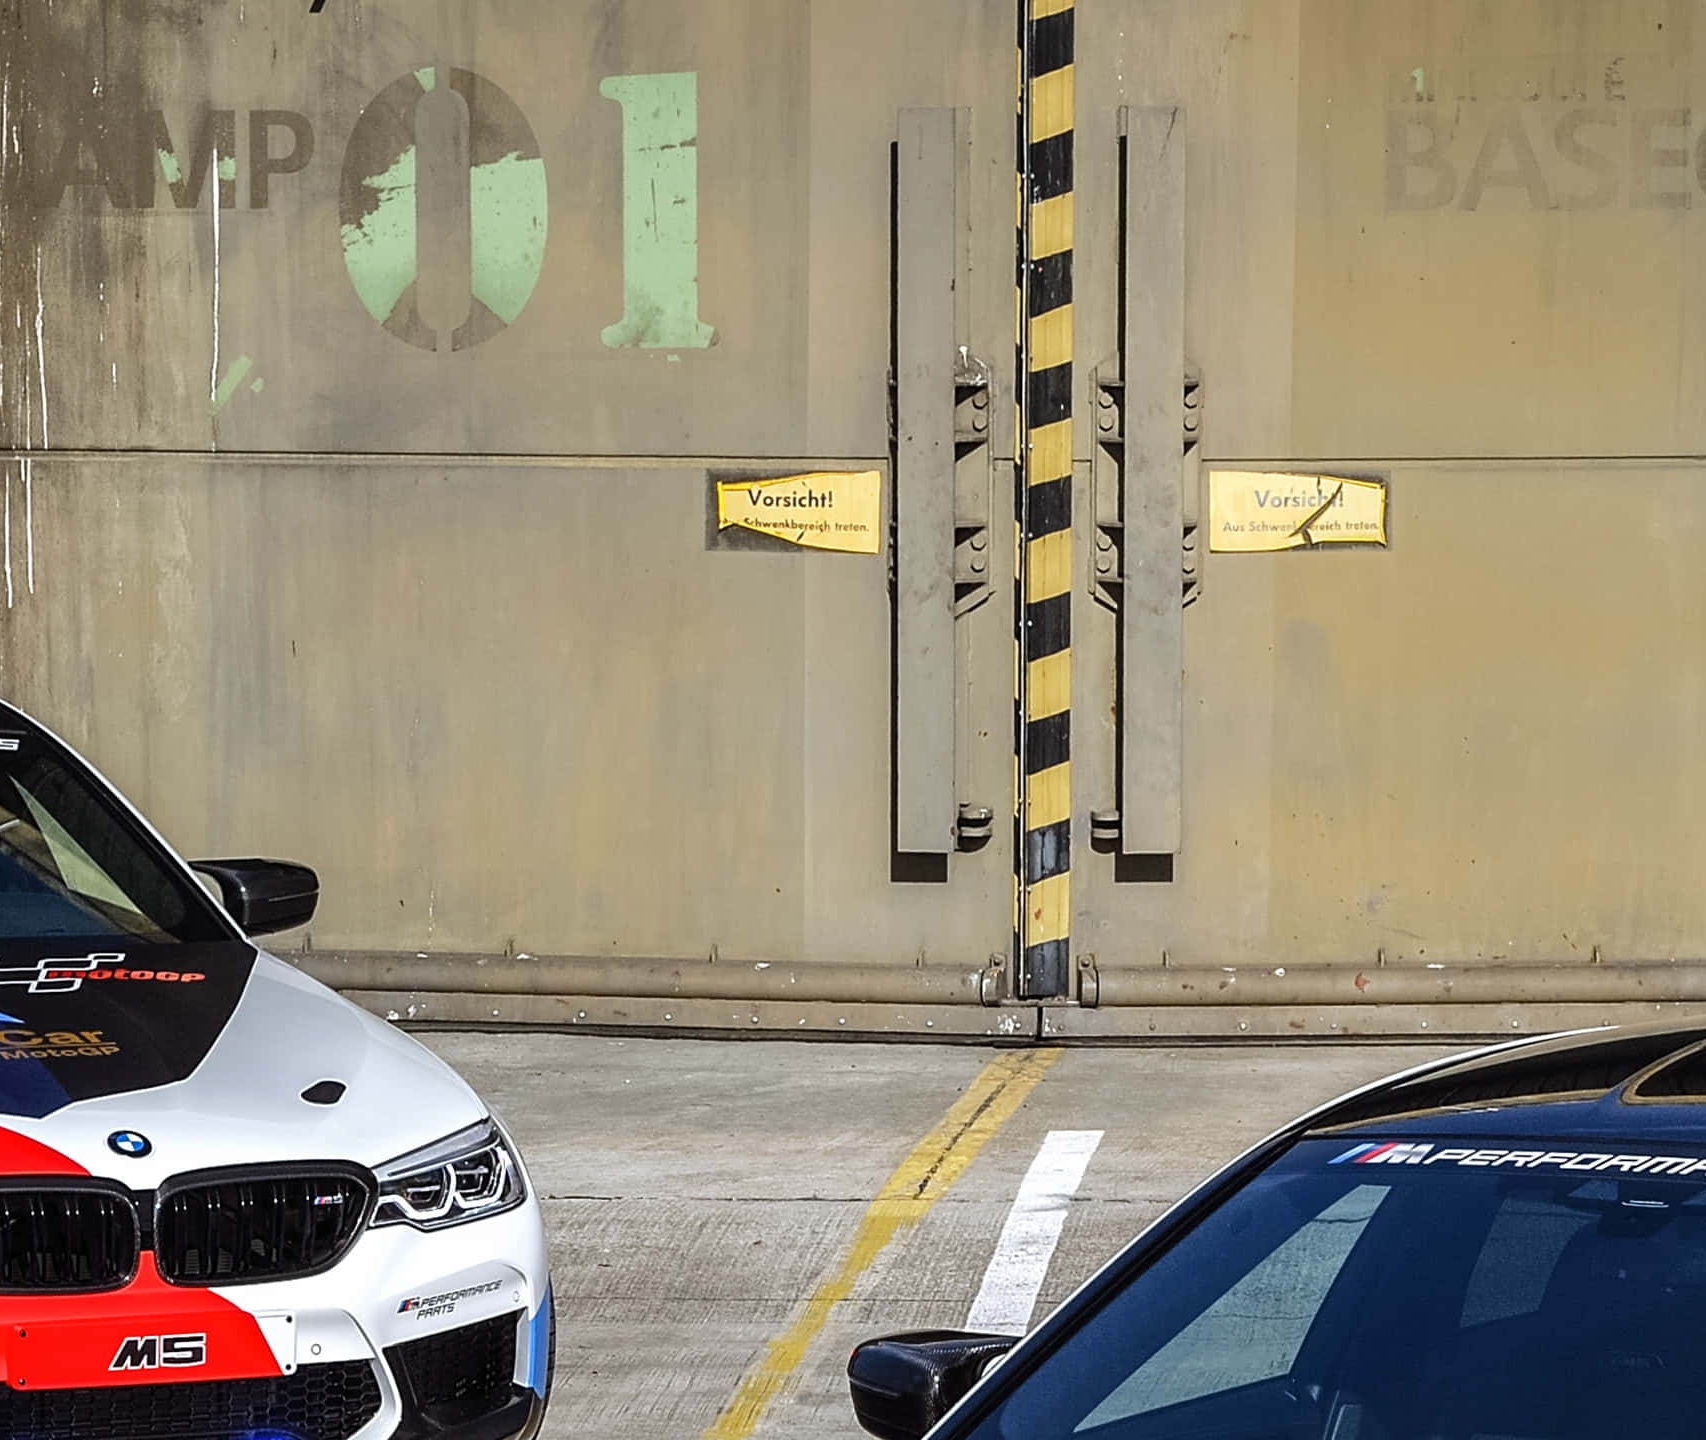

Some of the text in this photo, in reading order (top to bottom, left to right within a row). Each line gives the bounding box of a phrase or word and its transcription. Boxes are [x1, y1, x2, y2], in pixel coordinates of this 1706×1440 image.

[339, 66, 720, 352] 01
[748, 489, 833, 508] Vorsicht!
[420, 1280, 503, 1308] PERFORMANCE
[416, 1302, 455, 1320] PARTS
[108, 1332, 206, 1371] M5
